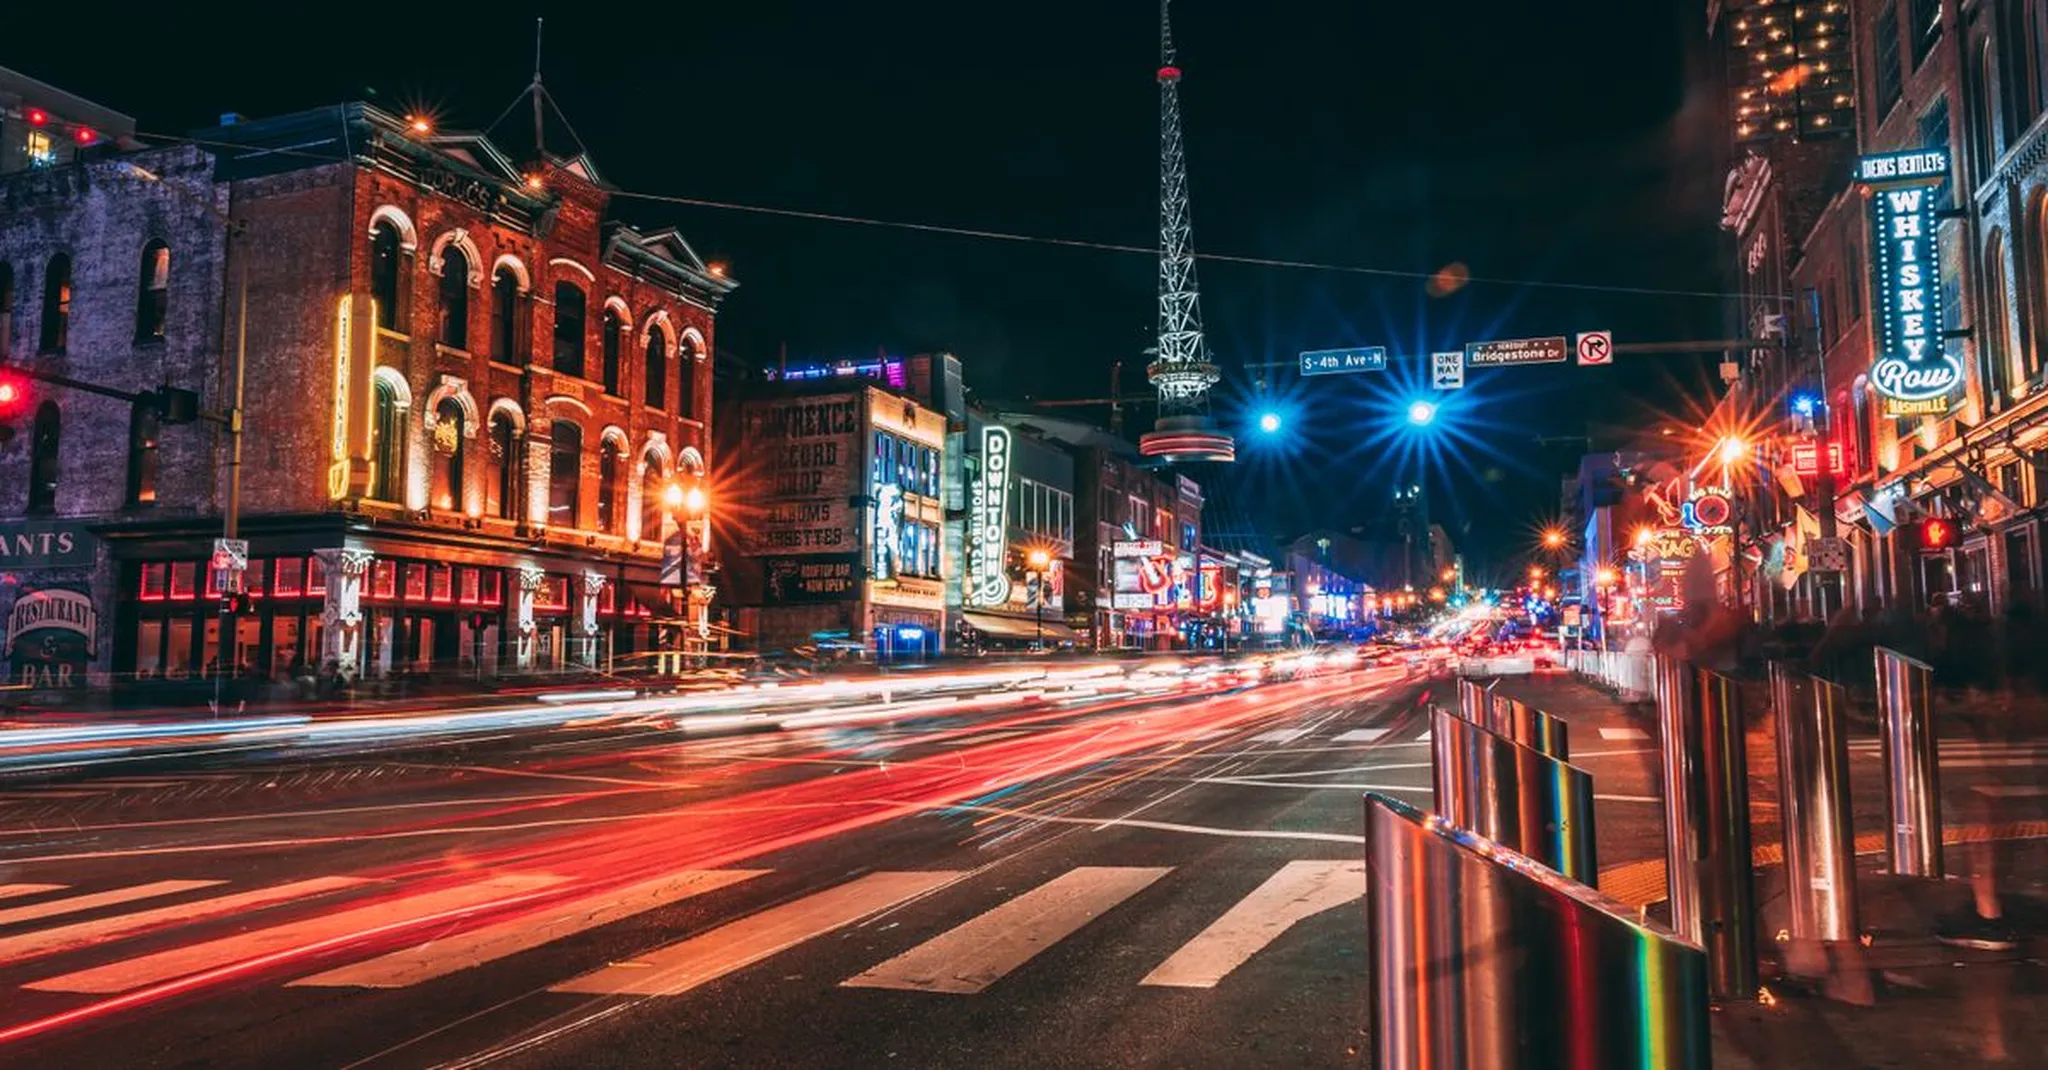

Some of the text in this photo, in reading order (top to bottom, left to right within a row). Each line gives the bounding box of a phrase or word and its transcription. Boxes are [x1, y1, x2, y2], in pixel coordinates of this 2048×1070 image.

[1862, 157, 1896, 178] DIERKS
[1888, 190, 1926, 361] WHISKEY
[1437, 355, 1459, 364] ONE
[1472, 349, 1560, 362] Bridgestone Dr
[1437, 365, 1460, 374] WAY
[1880, 359, 1953, 398] Row
[1885, 396, 1948, 415] NASHVILLE
[768, 504, 831, 524] ALBUMS
[971, 480, 983, 546] SPORTING
[986, 434, 1005, 577] DOWNTOWN
[755, 528, 843, 549] CASSETTES
[801, 563, 834, 577] ROOFTOP
[835, 563, 851, 577] BAR
[806, 578, 846, 592] NOW OPEN
[15, 598, 89, 632] RESTAURANT
[22, 663, 75, 688] BAR
